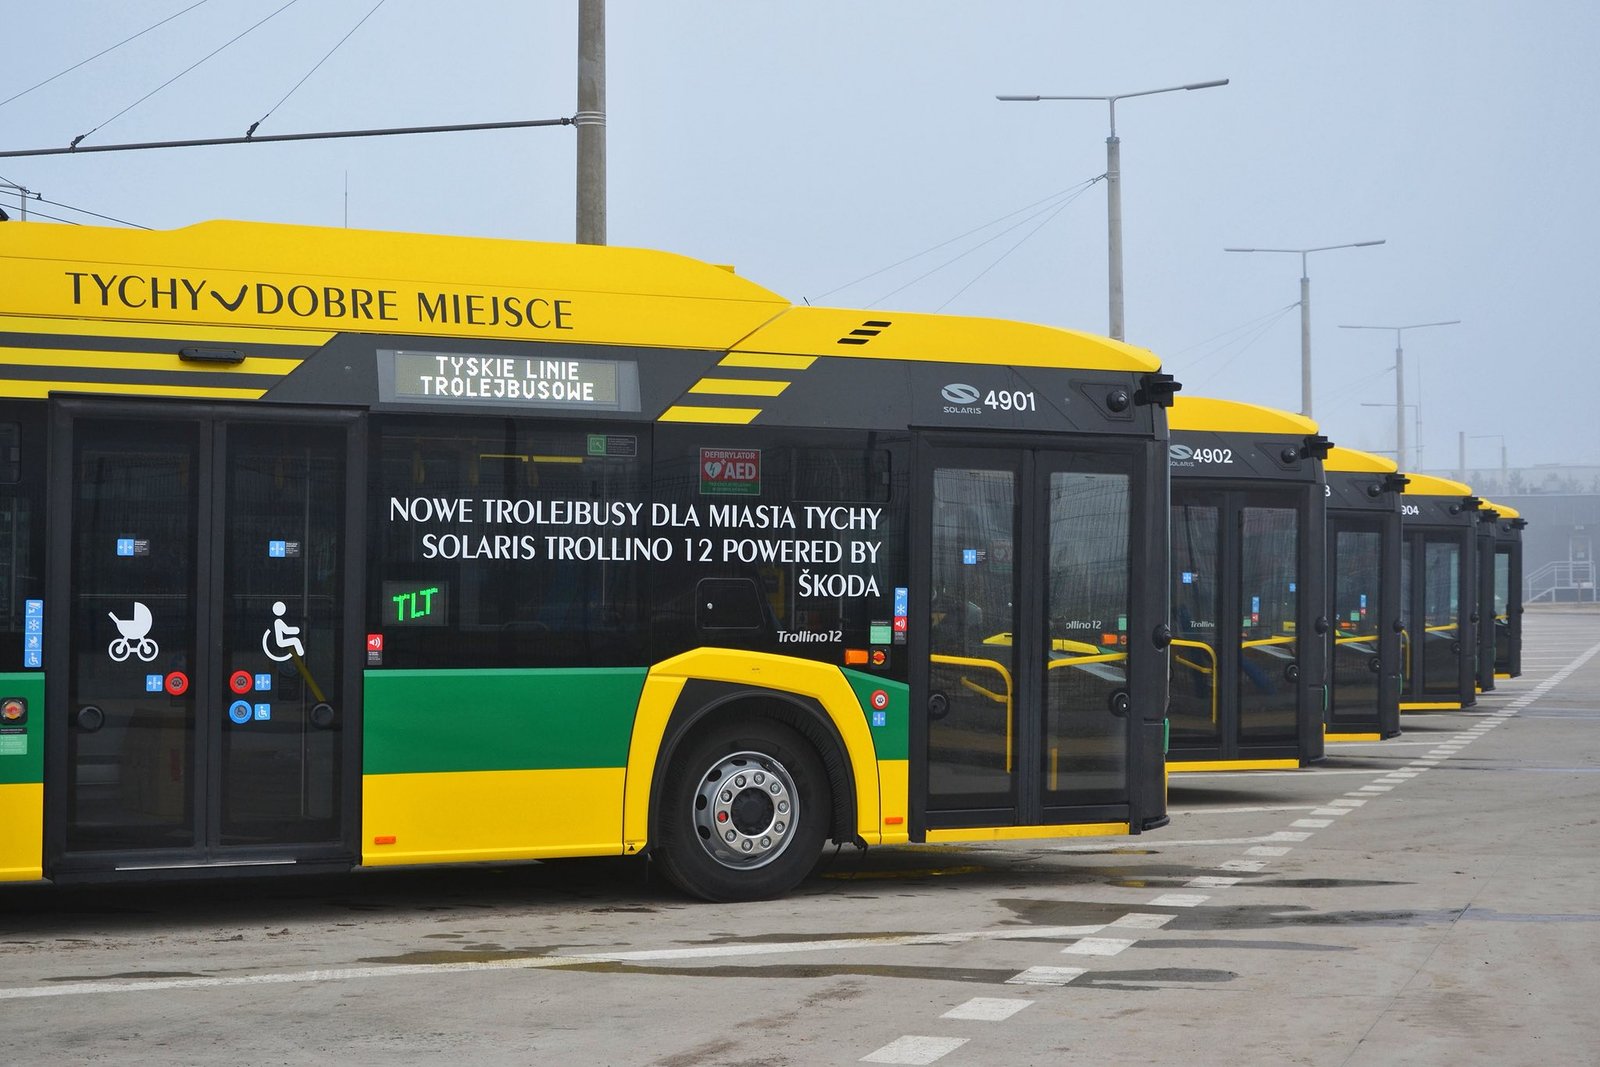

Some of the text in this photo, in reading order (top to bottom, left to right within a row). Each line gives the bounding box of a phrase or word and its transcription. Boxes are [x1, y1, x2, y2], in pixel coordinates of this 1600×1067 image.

[65, 272, 574, 330] TYCHY DOBRE MIEJSCE
[435, 356, 580, 381] TYSKIE LINIE
[420, 376, 594, 401] TROLEJBUSOWE
[984, 390, 1036, 412] 4901
[943, 406, 982, 415] SOLARIS
[704, 450, 756, 460] DEFIBRYLATOR
[1192, 448, 1234, 464] 4902
[723, 462, 757, 480] AED
[390, 497, 882, 531] NOWE TROLEJBUSY DLA MIASTA TYCHY
[1401, 504, 1420, 516] 904
[422, 533, 882, 564] SOLARIS TROLLINO 12 POWERED BY
[798, 568, 881, 598] ŠKODA
[393, 587, 438, 621] TLT
